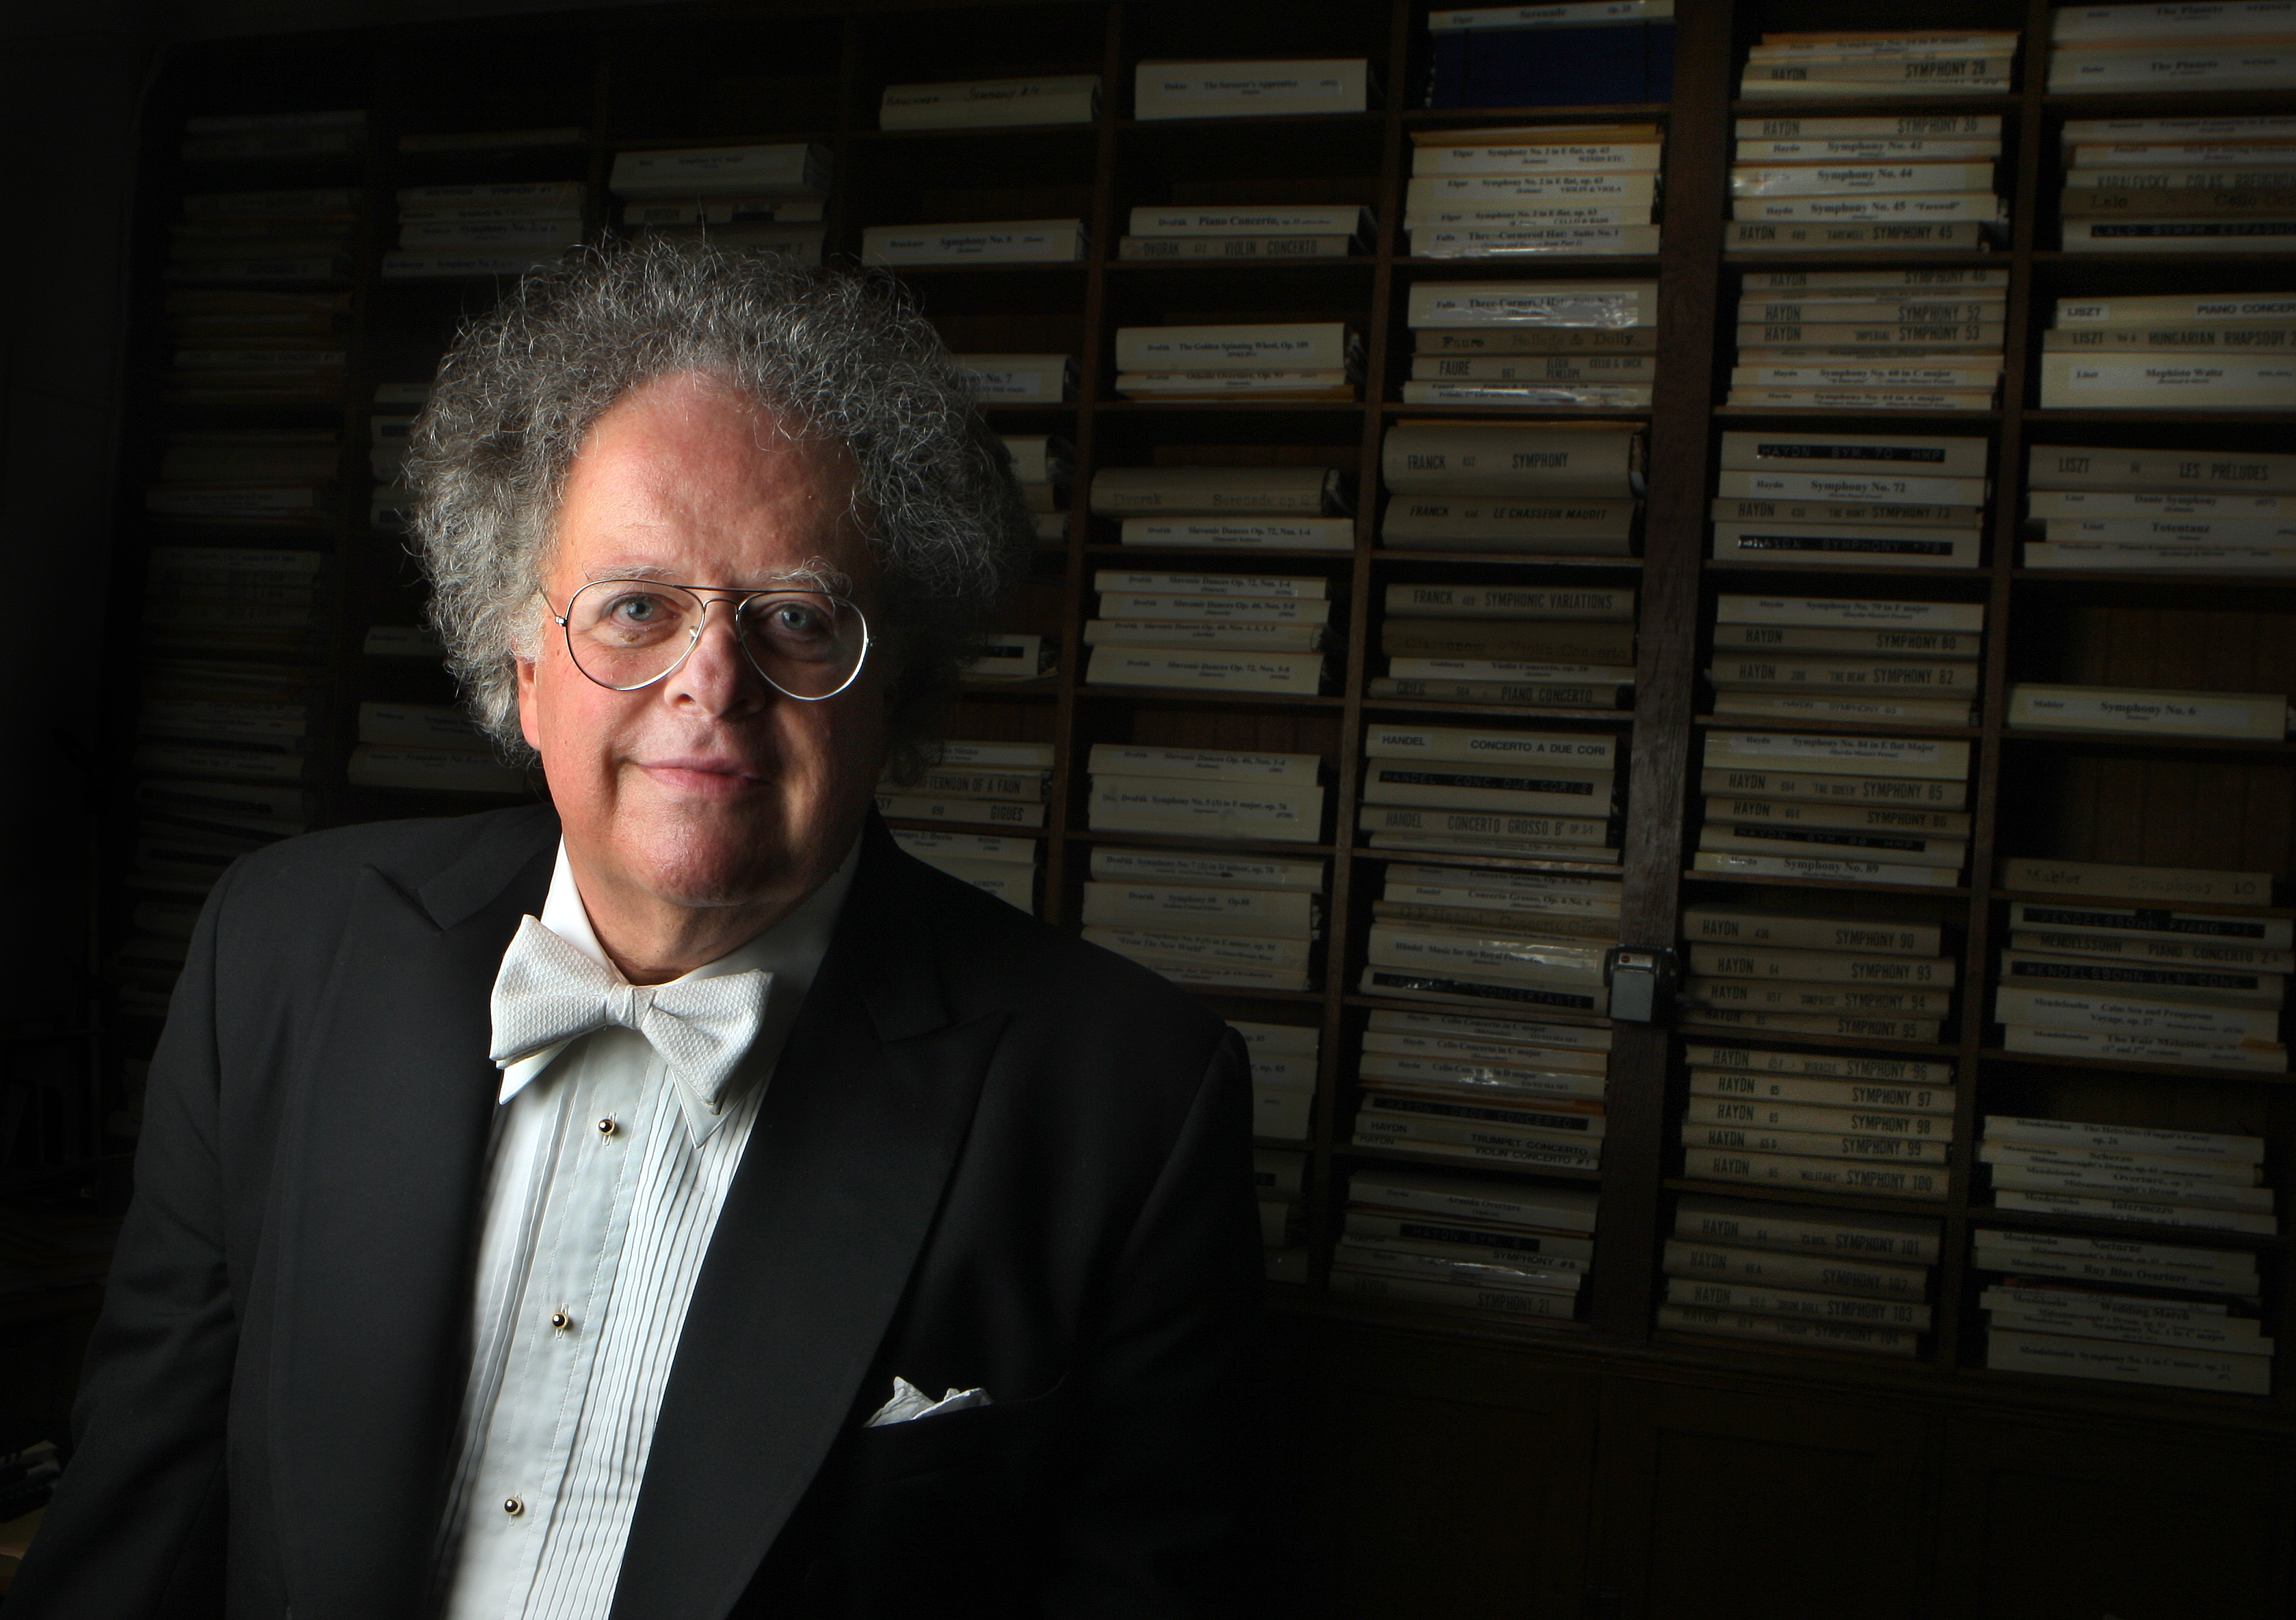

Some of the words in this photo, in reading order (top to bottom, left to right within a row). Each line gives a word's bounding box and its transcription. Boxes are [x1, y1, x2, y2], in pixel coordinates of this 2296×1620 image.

[1771, 68, 1806, 80] HAYDN
[1905, 60, 1965, 77] SYMPHONY
[1763, 120, 1799, 136] HAYDN
[1897, 118, 1957, 134] SYMPHONY
[1818, 170, 1874, 181] Symphony
[1811, 203, 1867, 215] Symphony
[1739, 226, 1776, 240] HAYDN
[1873, 226, 1932, 240] SYMPHONY
[1938, 225, 1953, 239] 45
[1267, 240, 1317, 254] CONCERTO
[1765, 306, 1801, 321] HAYDN
[1899, 306, 1959, 321] SYMPHONY
[1967, 305, 1981, 321] 52
[2198, 305, 2236, 315] PIANO
[1765, 326, 1801, 342] HAYDN
[1899, 326, 1958, 341] SYMPHONY
[1966, 326, 1979, 341] 53
[2073, 333, 2102, 345] LISZT
[1408, 455, 1445, 470] FRANCK
[1512, 453, 1568, 468] SYMPHONY
[2059, 457, 2090, 474] LISZT
[2180, 462, 2200, 478] LES
[1811, 481, 1867, 492] Symphony
[1410, 506, 1449, 516] FRANCK
[1493, 508, 1505, 518] LE
[1509, 509, 1561, 519] CHASSEUR
[1739, 503, 1774, 517] HAYDN
[1873, 506, 1930, 519] SYMPHONY
[1936, 508, 1950, 519] 73
[1414, 590, 1453, 605] FRANCK
[1485, 592, 1544, 607] SYMPHONIC
[1551, 594, 1612, 609] VARIATIONS
[1746, 629, 1782, 643] HAYDN
[1877, 634, 1936, 648] SYMPHONY
[1739, 664, 1776, 680] HAYDN
[1874, 669, 1932, 684] SYMPHONY
[1940, 669, 1953, 685] 82
[1501, 687, 1532, 701] PIANO
[1540, 688, 1592, 703] CONCERTO
[2100, 702, 2161, 716] Symphony
[1383, 735, 1425, 746] HANDEL
[1471, 740, 1531, 752] CONCERTO
[1537, 742, 1544, 752] A
[1551, 744, 1572, 754] DUE
[1578, 746, 1605, 756] CORI
[973, 778, 985, 792] OF
[988, 778, 993, 793] A
[998, 778, 1021, 794] FAUN
[1730, 773, 1765, 789] HAYDN
[1863, 782, 1922, 799] SYMPHONY
[991, 806, 1024, 821] GIGUES
[1734, 801, 1770, 816] HAYDN
[1868, 811, 1926, 827] SYMPHONY
[1386, 812, 1422, 828] HANDEL
[1448, 815, 1500, 833] CONCERTO
[1508, 819, 1548, 836] GROSSO
[1703, 920, 1739, 936] HAYDN
[1836, 930, 1894, 948] SYMPHONY
[1901, 933, 1914, 948] 90
[2149, 944, 2182, 957] PIANO
[2193, 947, 2254, 964] CONCERTO
[1718, 959, 1754, 973] HAYDN
[1851, 963, 1910, 980] SYMPHONY
[1918, 966, 1931, 981] 93
[1711, 985, 1747, 1000] HAYDN
[1846, 992, 1903, 1009] SYMPHONY
[1838, 1019, 1897, 1035] SYMPHONY
[1719, 1077, 1754, 1093] HAYDN
[1853, 1087, 1910, 1105] SYMPHONY
[1918, 1091, 1931, 1107] 97
[1718, 1104, 1753, 1121] HAYDN
[1851, 1115, 1910, 1132] SYMPHONY
[1917, 1119, 1930, 1134] 98
[1371, 1121, 1408, 1134] HAYDN
[1471, 1134, 1521, 1147] TRUMPET
[1527, 1141, 1587, 1156] CONCERTO
[1708, 1130, 1744, 1146] HAYDN
[1843, 1138, 1901, 1154] SYMPHONY
[1908, 1143, 1921, 1156] 99
[1713, 1158, 1750, 1175] HAYDN
[1847, 1170, 1905, 1190] SYMPHONY
[1703, 1219, 1739, 1236] HAYDN
[1835, 1234, 1894, 1253] SYMPHONY
[1691, 1251, 1726, 1269] HAYDN
[1823, 1269, 1881, 1289] SYMPHONY
[1695, 1286, 1730, 1305] HAYDN
[1827, 1301, 1886, 1319] SYMPHONY
